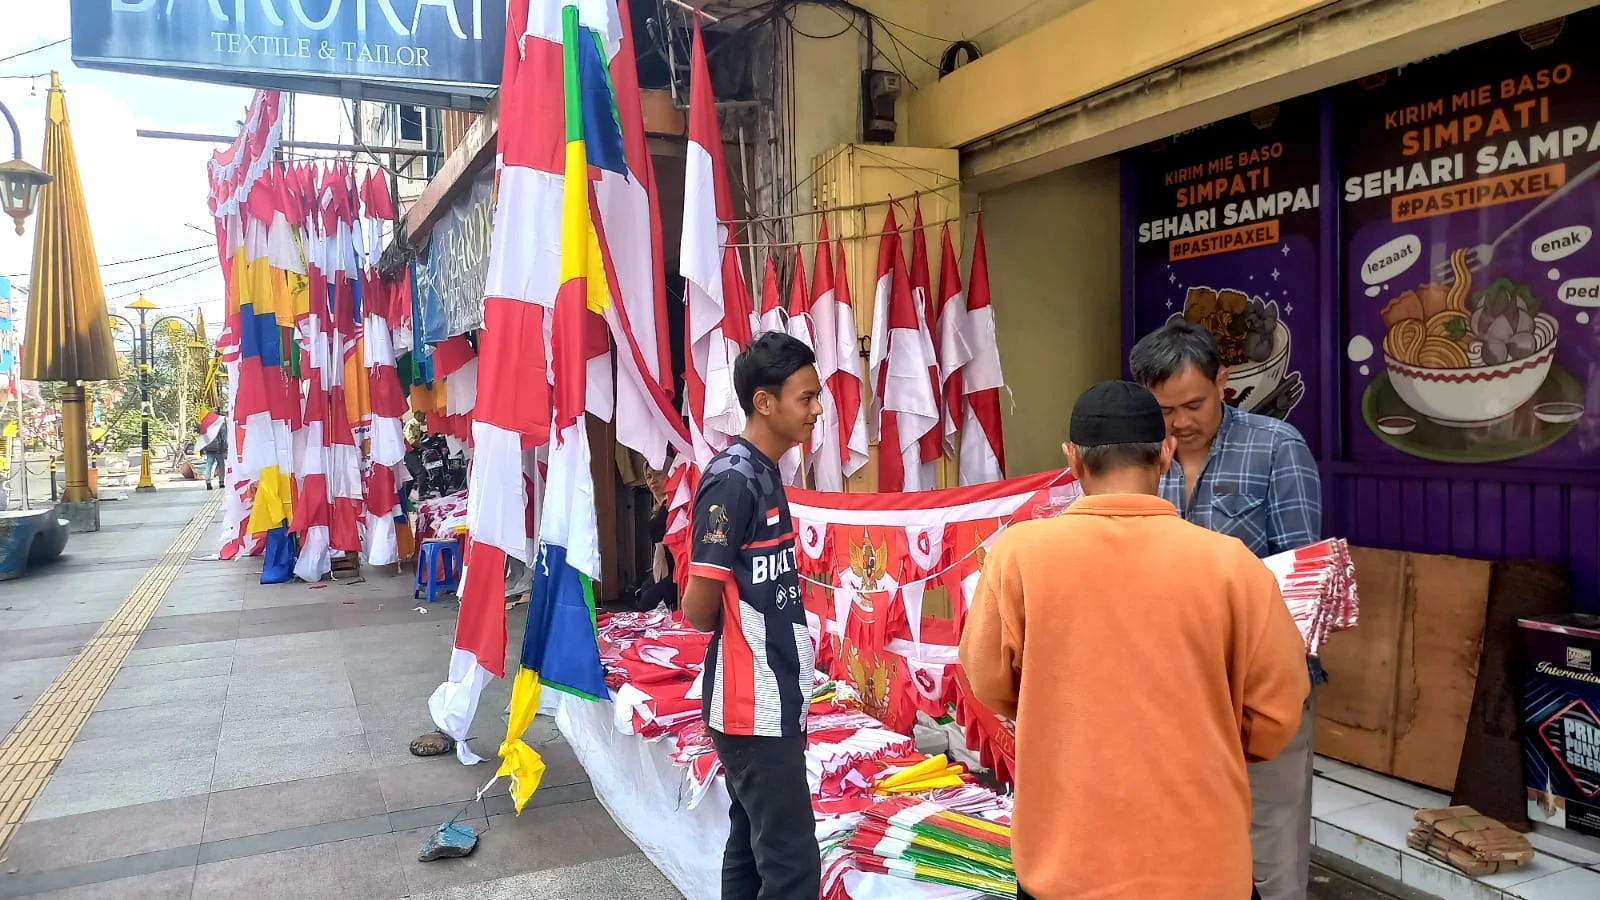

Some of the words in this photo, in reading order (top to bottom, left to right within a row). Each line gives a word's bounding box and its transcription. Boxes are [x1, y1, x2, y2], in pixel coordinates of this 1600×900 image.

[211, 31, 311, 58] TEXTILE
[318, 40, 336, 60] &
[342, 41, 431, 67] TAILOR
[1384, 99, 1443, 130] KIRIM
[1452, 85, 1492, 113] MIE
[1500, 63, 1572, 99] BASO
[1401, 96, 1549, 157] SIMPATI
[1165, 163, 1203, 187] KIRIM
[1208, 155, 1234, 176] MIE
[1238, 142, 1283, 167] BASO
[1176, 166, 1269, 208] SIMPATI
[1344, 153, 1464, 203] SEHARI
[1138, 207, 1216, 243] SEHARI
[1223, 184, 1320, 226] SAMPAI
[1397, 171, 1559, 218] #PASTIPAXEL
[1173, 227, 1275, 258] #PASTIPAXEL
[1366, 243, 1414, 274] lezaaat
[1540, 231, 1582, 254] enak
